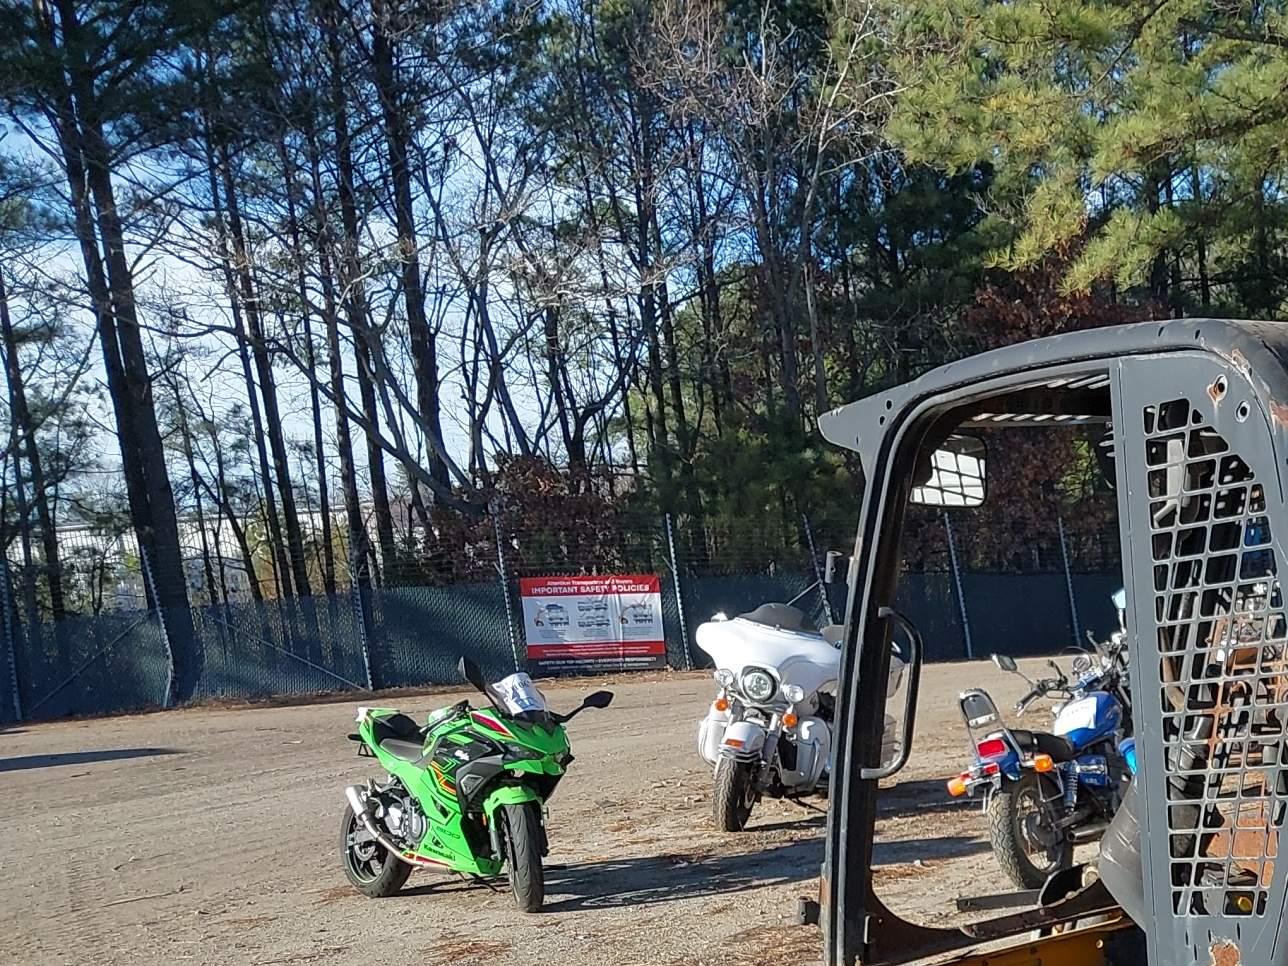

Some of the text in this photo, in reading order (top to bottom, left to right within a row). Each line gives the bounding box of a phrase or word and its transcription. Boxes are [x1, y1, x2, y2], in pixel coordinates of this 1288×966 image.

[531, 583, 650, 595] IMPORTANT SAFETY POLICIES
